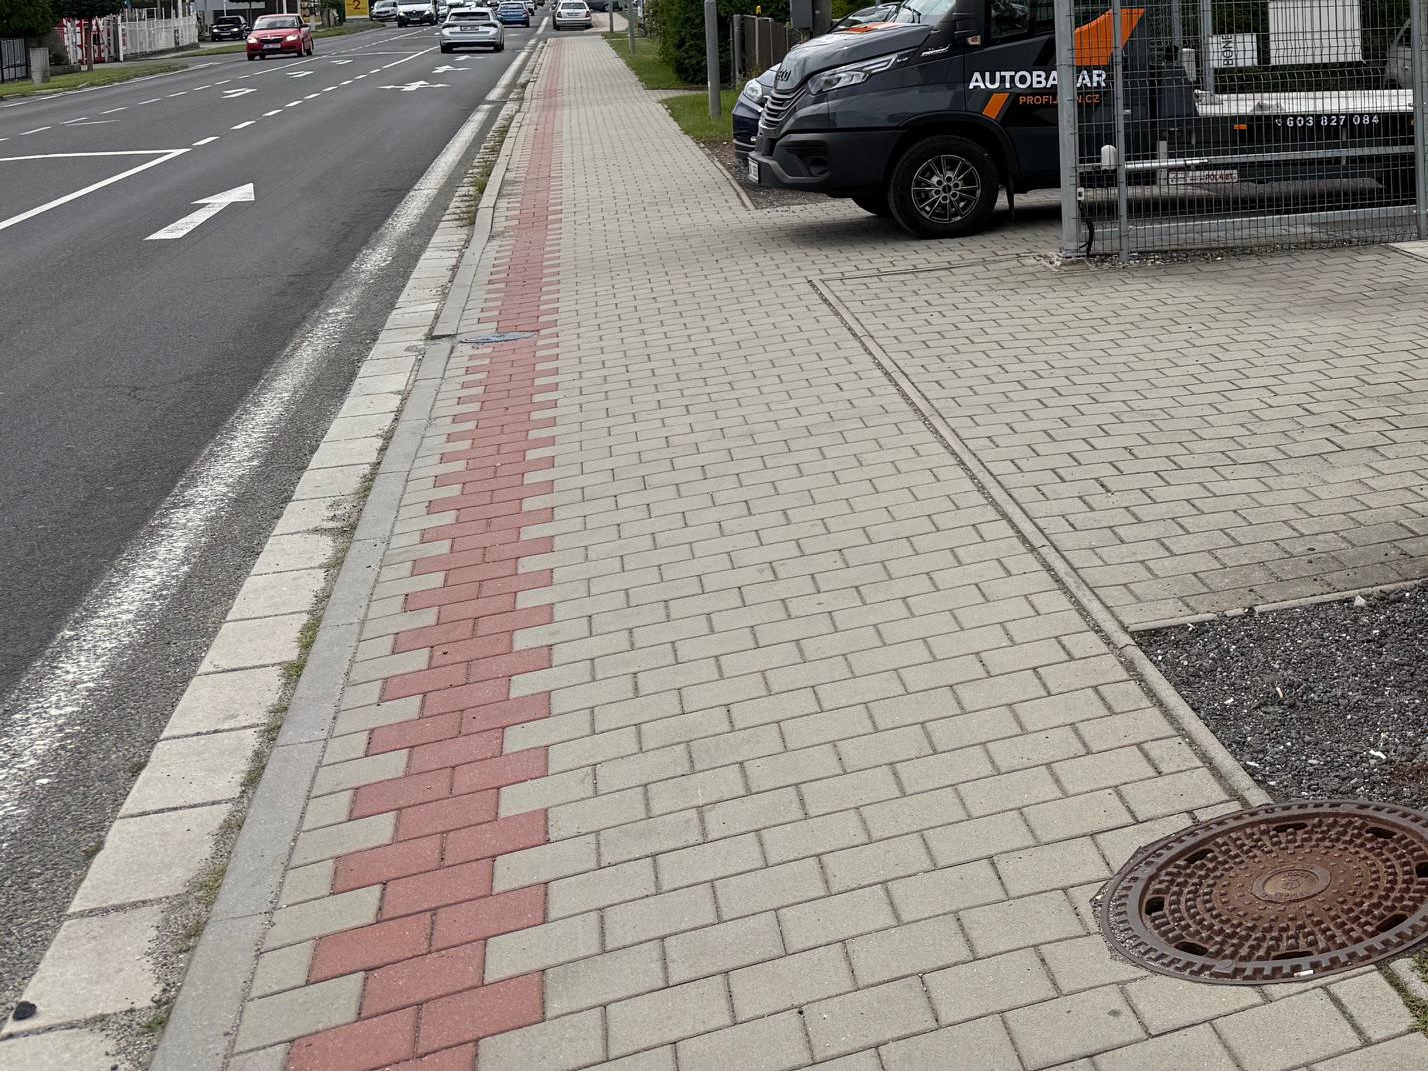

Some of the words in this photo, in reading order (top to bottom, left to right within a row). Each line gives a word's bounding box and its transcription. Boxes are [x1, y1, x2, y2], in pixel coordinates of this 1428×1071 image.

[969, 69, 1107, 89] AUTOBAAR
[1286, 116, 1314, 127] 603
[1320, 115, 1346, 126] 827
[1352, 114, 1380, 125] 084
